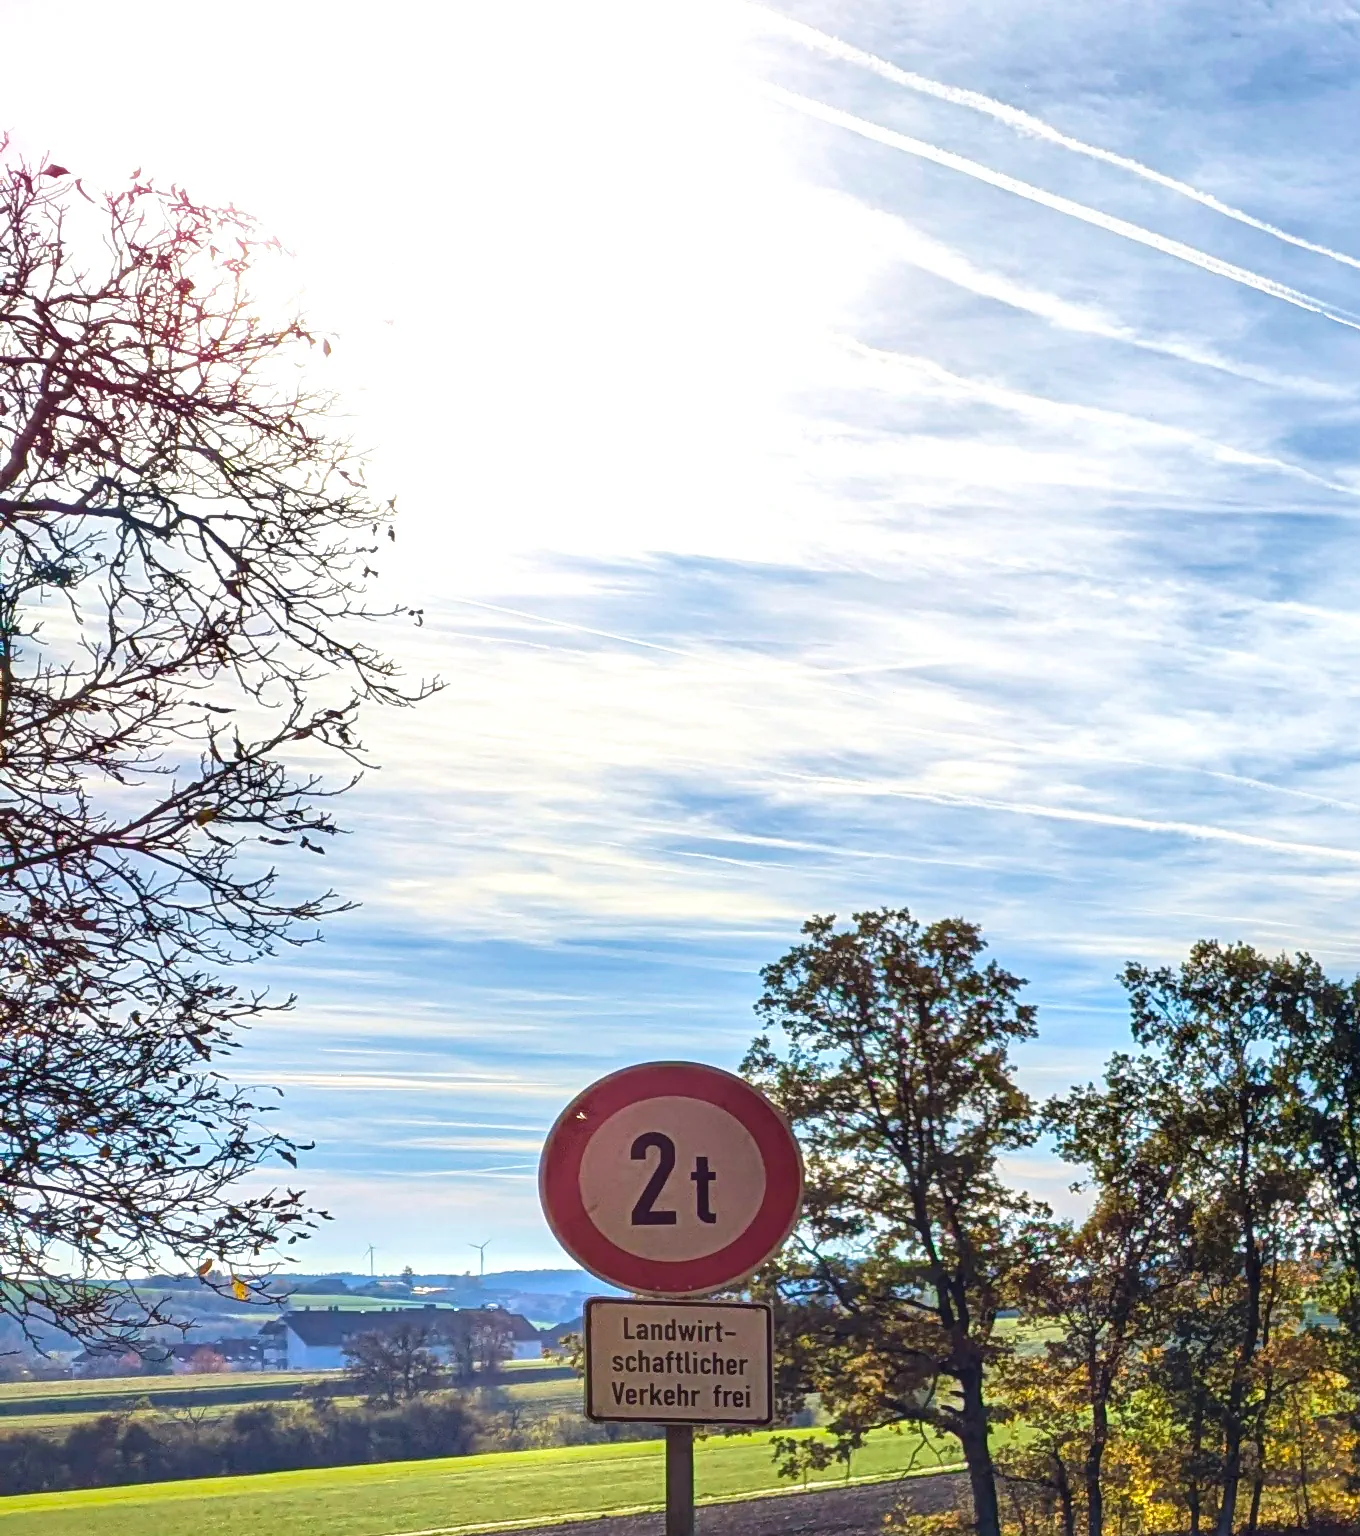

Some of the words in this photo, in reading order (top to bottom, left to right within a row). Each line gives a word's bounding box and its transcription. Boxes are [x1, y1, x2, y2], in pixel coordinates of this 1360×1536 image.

[623, 1317, 737, 1343] Landwirt-
[611, 1350, 749, 1376] schaftlicher
[611, 1382, 701, 1407] Verkehr
[713, 1385, 751, 1408] frei
